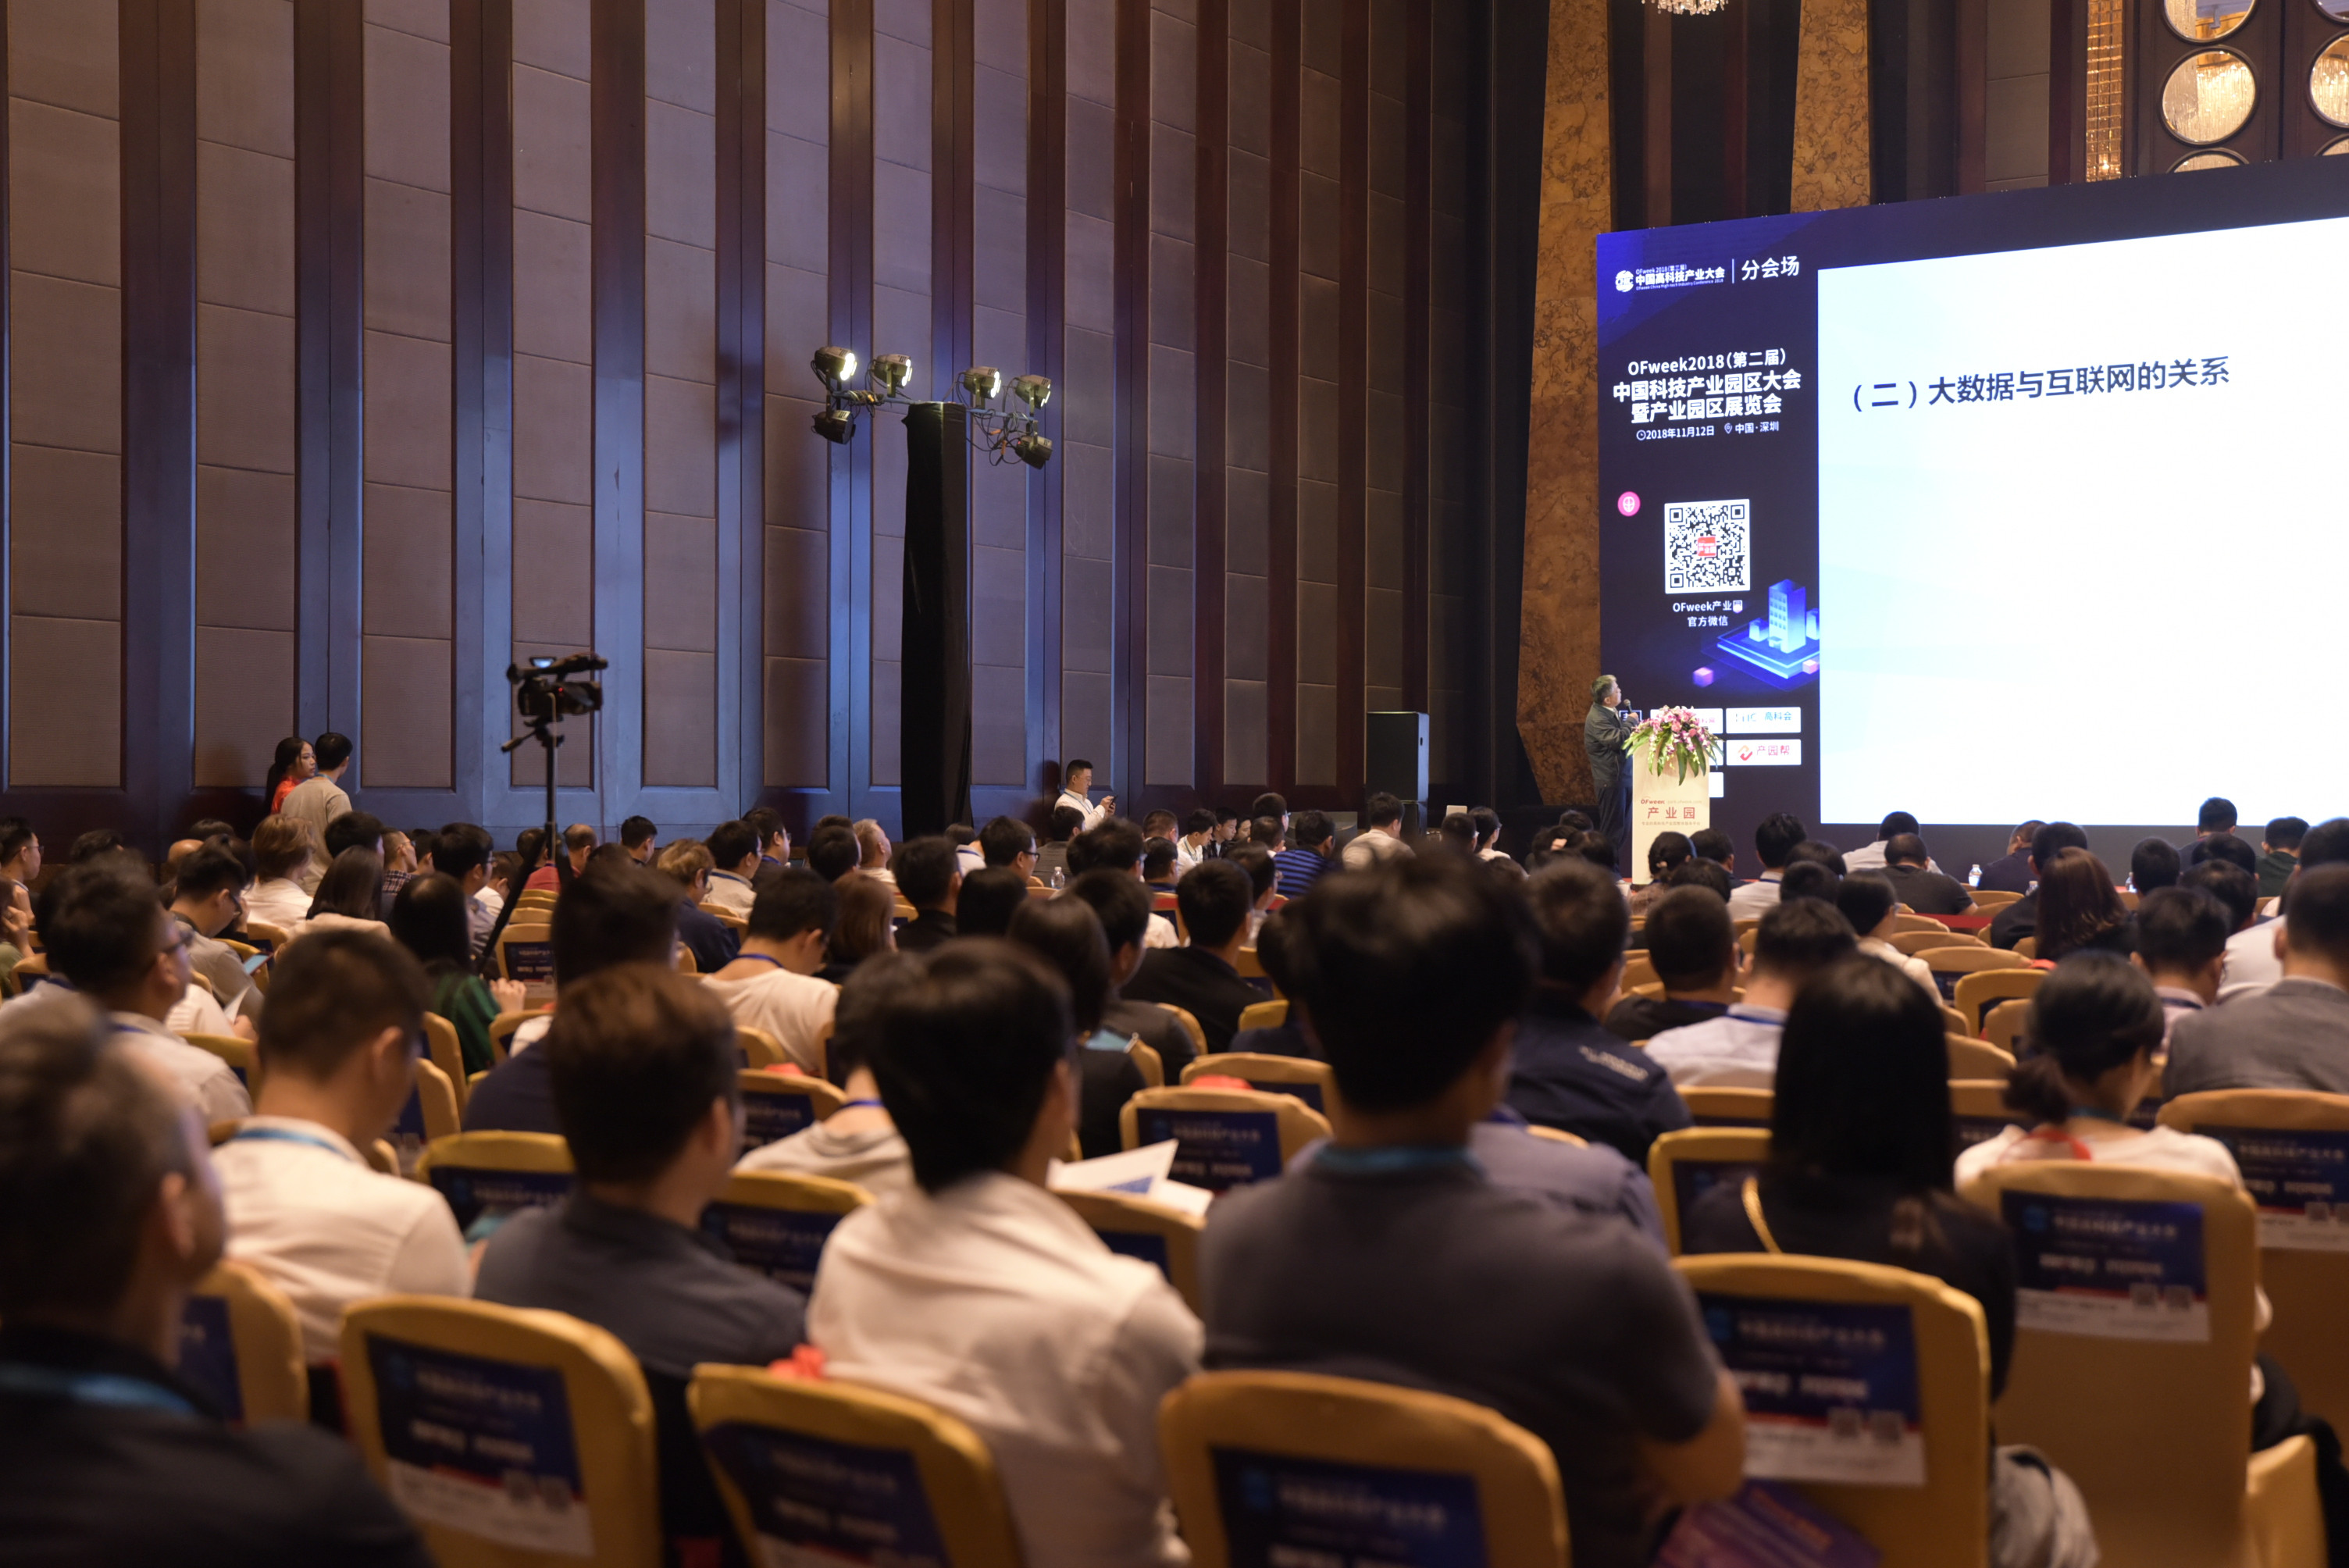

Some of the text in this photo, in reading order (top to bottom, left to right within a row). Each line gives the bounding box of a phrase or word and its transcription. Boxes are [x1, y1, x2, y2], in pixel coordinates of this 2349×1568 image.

[1635, 266, 1725, 286] 中国高科技产业大会
[1741, 255, 1800, 281] 分会场
[1613, 369, 1802, 402] 中国科技产业园区大会
[1631, 393, 1782, 423] 暨产业园区展览会
[1645, 426, 1715, 440] 2018年11月12日
[1688, 615, 1728, 628] 官方微信
[1756, 744, 1790, 756] 产园帮
[1647, 806, 1695, 819] 产业园
